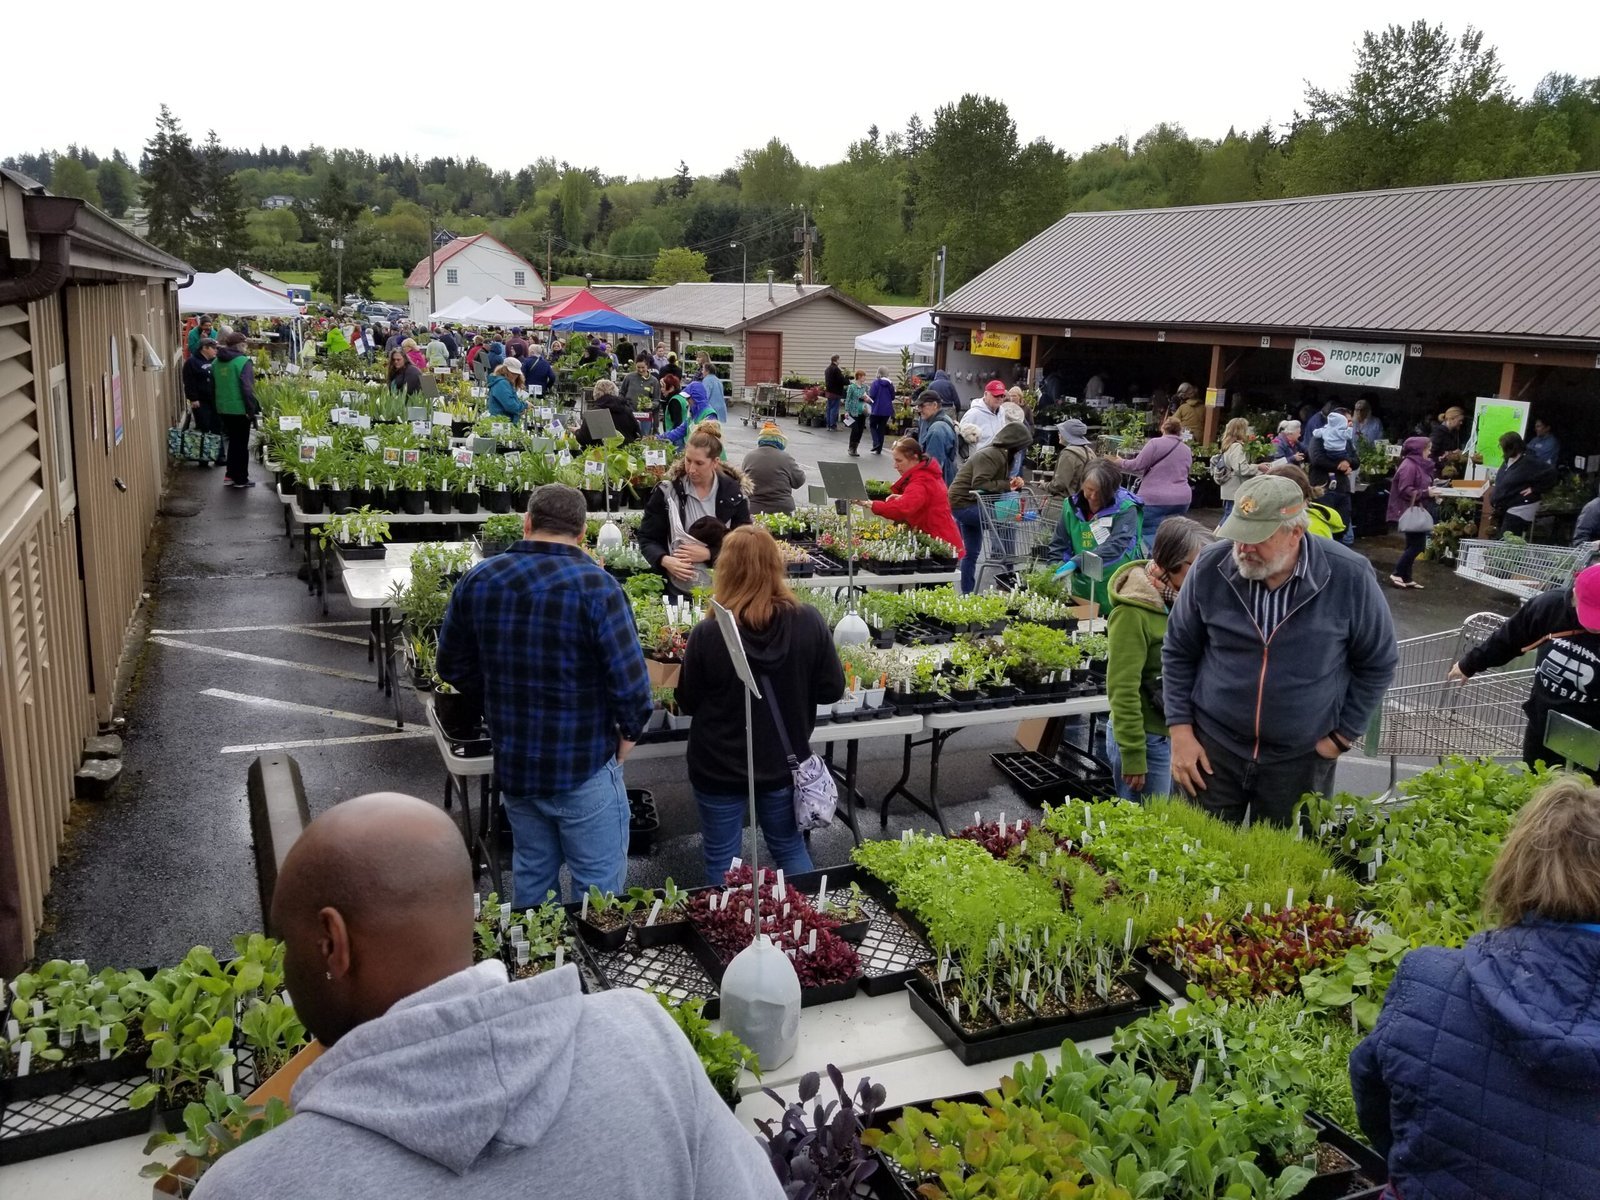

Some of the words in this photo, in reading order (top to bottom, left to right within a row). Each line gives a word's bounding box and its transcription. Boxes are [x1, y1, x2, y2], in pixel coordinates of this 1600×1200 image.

[1330, 349, 1402, 364] PROPAGATION
[1411, 346, 1422, 354] 100
[1344, 364, 1381, 378] GROUP
